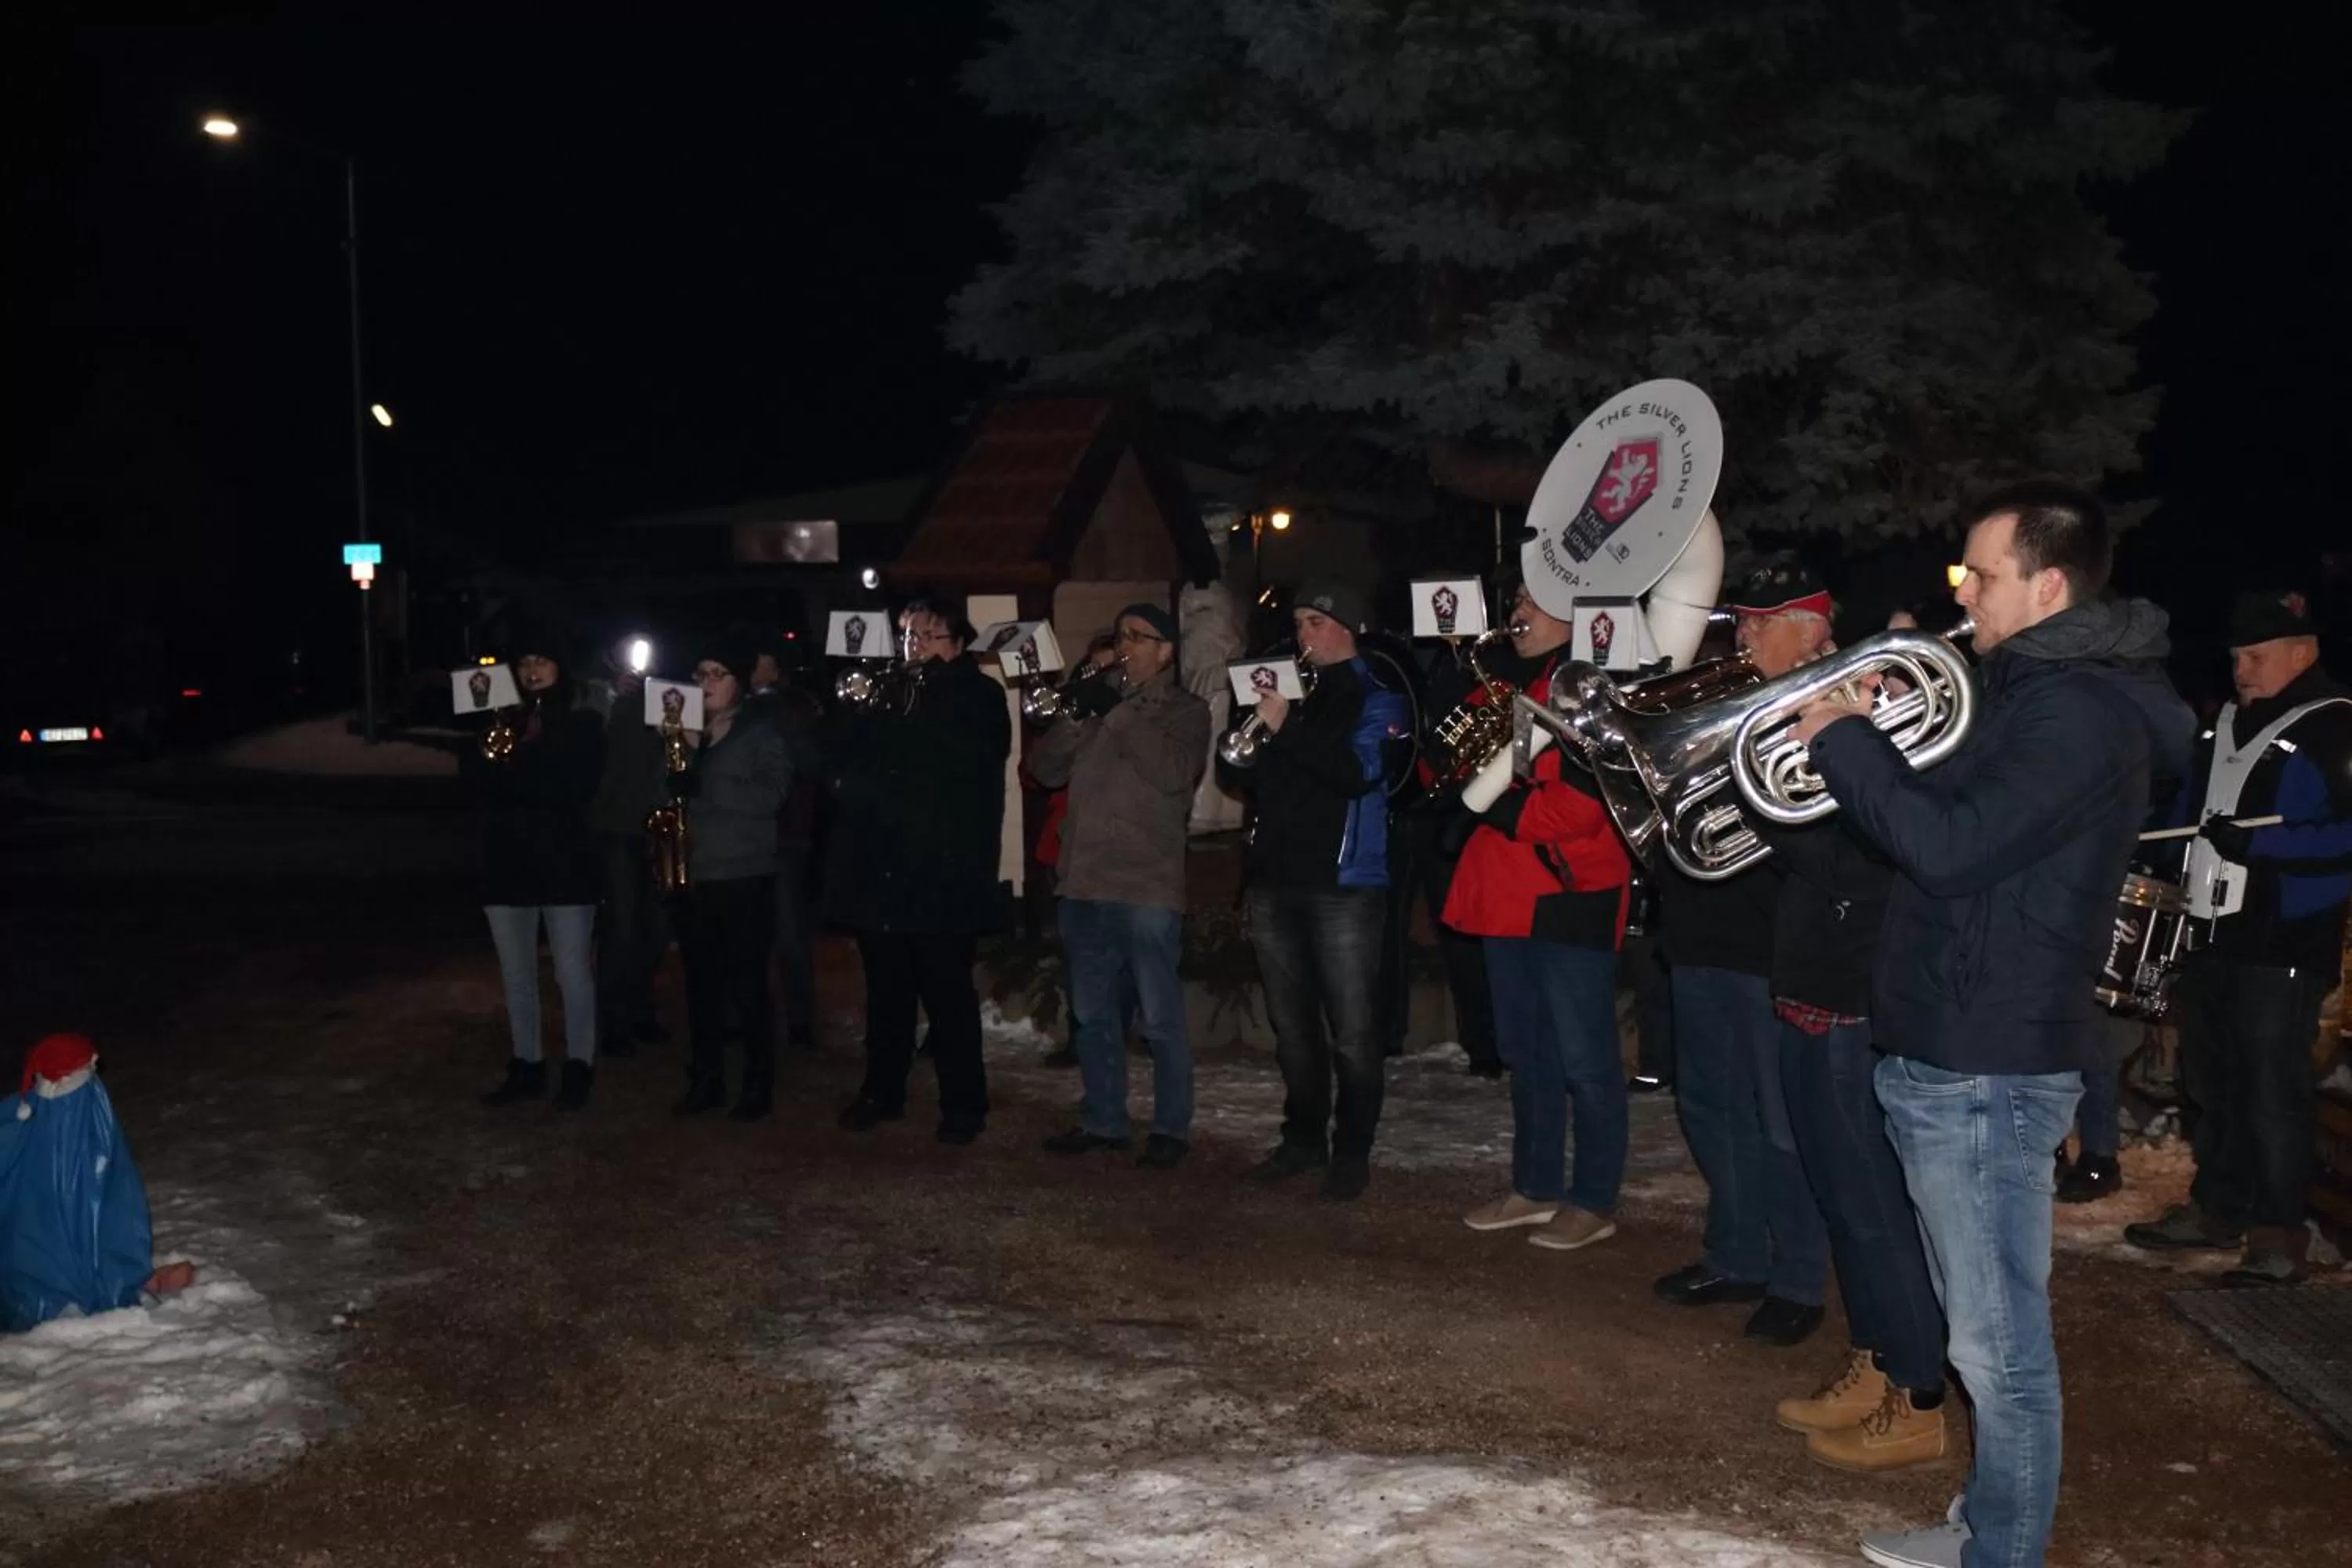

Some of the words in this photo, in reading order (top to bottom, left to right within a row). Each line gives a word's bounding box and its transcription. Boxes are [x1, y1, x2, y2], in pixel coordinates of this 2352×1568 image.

[1595, 405, 1632, 430] THE
[1639, 402, 1687, 437] SILVER
[1671, 441, 1693, 510] LIONS
[1541, 538, 1581, 587] SONTRA
